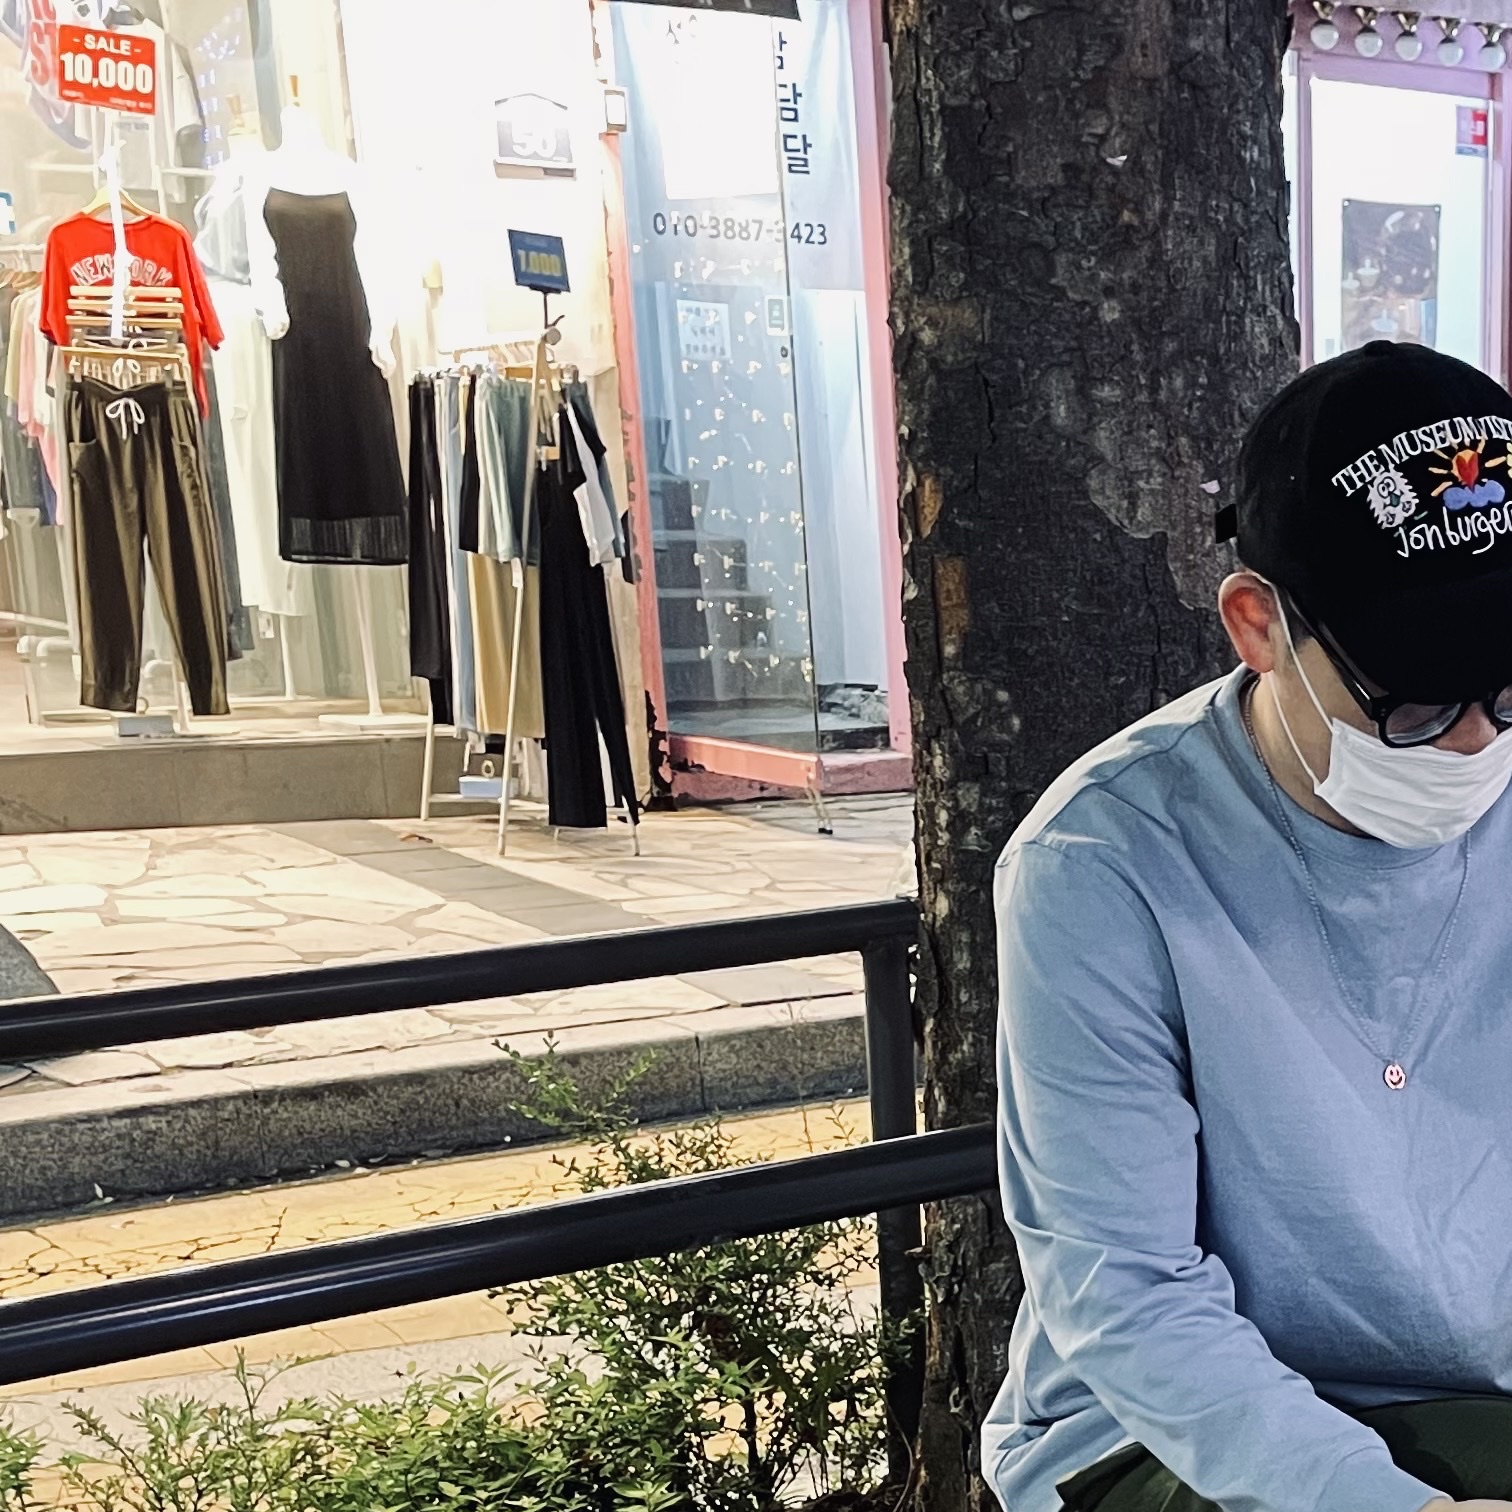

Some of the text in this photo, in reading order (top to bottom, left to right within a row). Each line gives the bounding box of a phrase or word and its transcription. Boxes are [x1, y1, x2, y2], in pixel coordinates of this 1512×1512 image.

[84, 34, 131, 55] SALE
[59, 51, 153, 94] 10,000
[70, 253, 173, 287] NEW ORK
[1331, 450, 1386, 497] THE
[1377, 416, 1476, 465] MUSEUM
